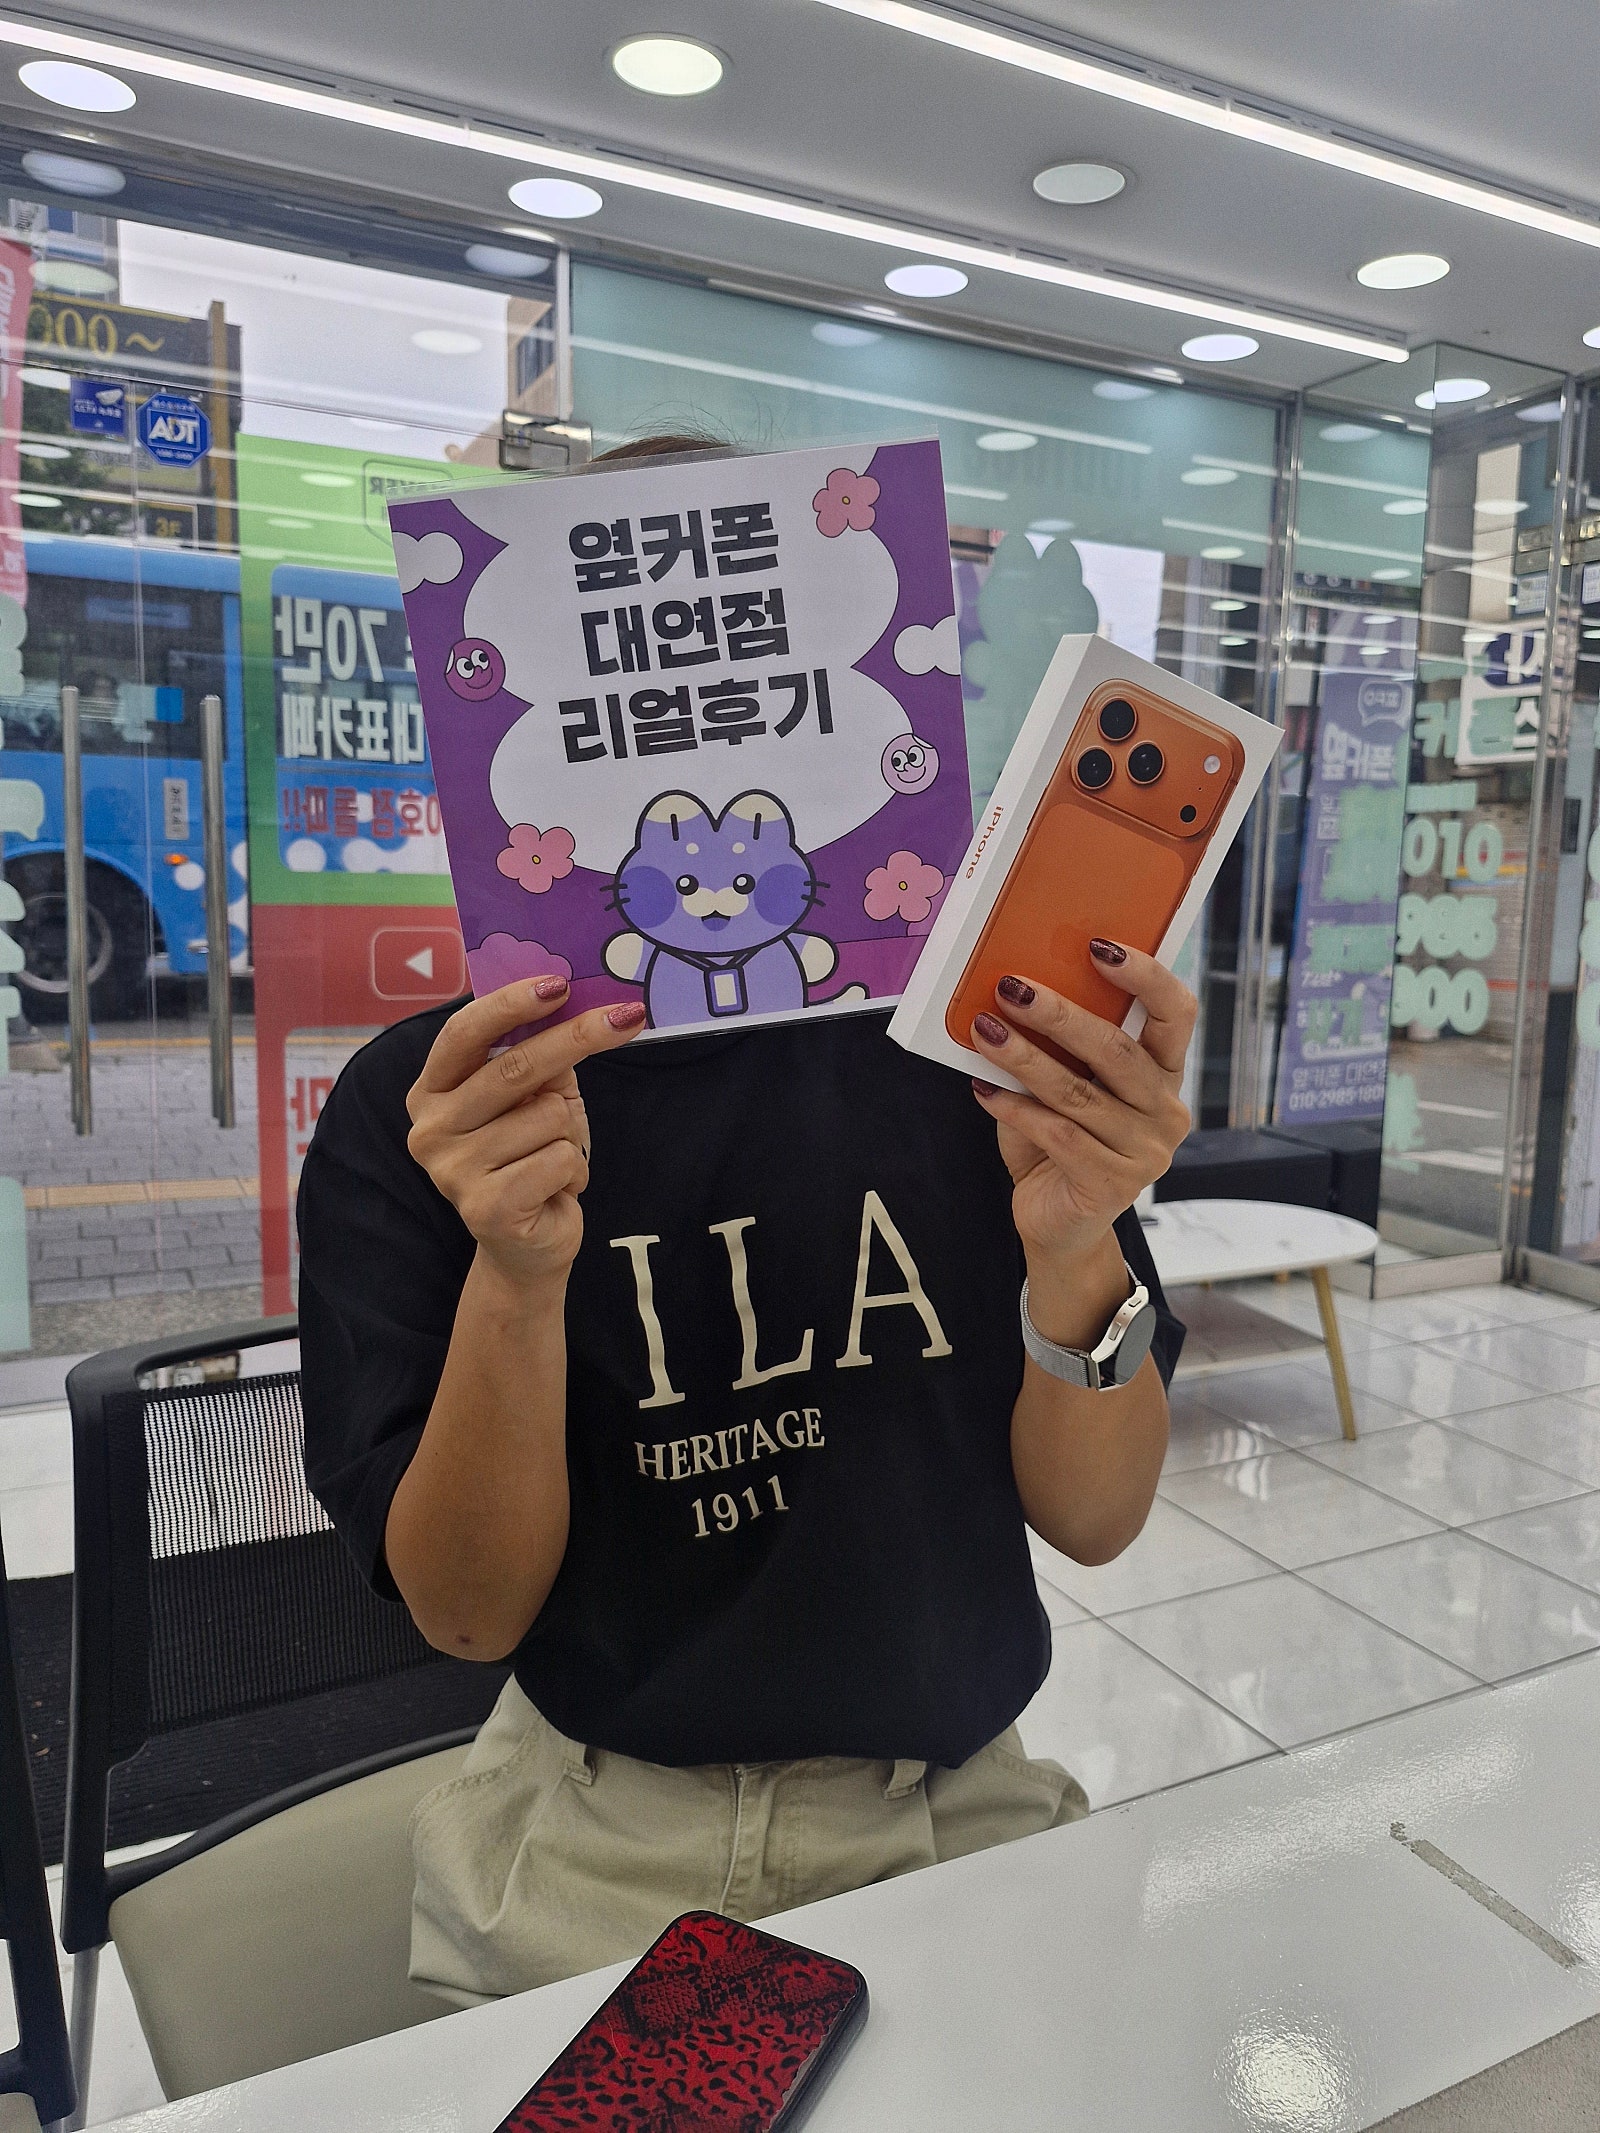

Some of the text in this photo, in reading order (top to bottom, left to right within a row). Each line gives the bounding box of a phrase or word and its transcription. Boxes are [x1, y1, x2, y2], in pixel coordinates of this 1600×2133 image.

[149, 416, 199, 444] ADT
[569, 502, 779, 593] 옆커폰
[580, 588, 790, 676] 대연점
[558, 668, 834, 763] 리얼후기
[966, 805, 1004, 879] iPhone
[1401, 817, 1503, 883] 010
[610, 1190, 953, 1409] ILA
[634, 1408, 826, 1480] HERITAGE
[691, 1475, 789, 1537] 1911
